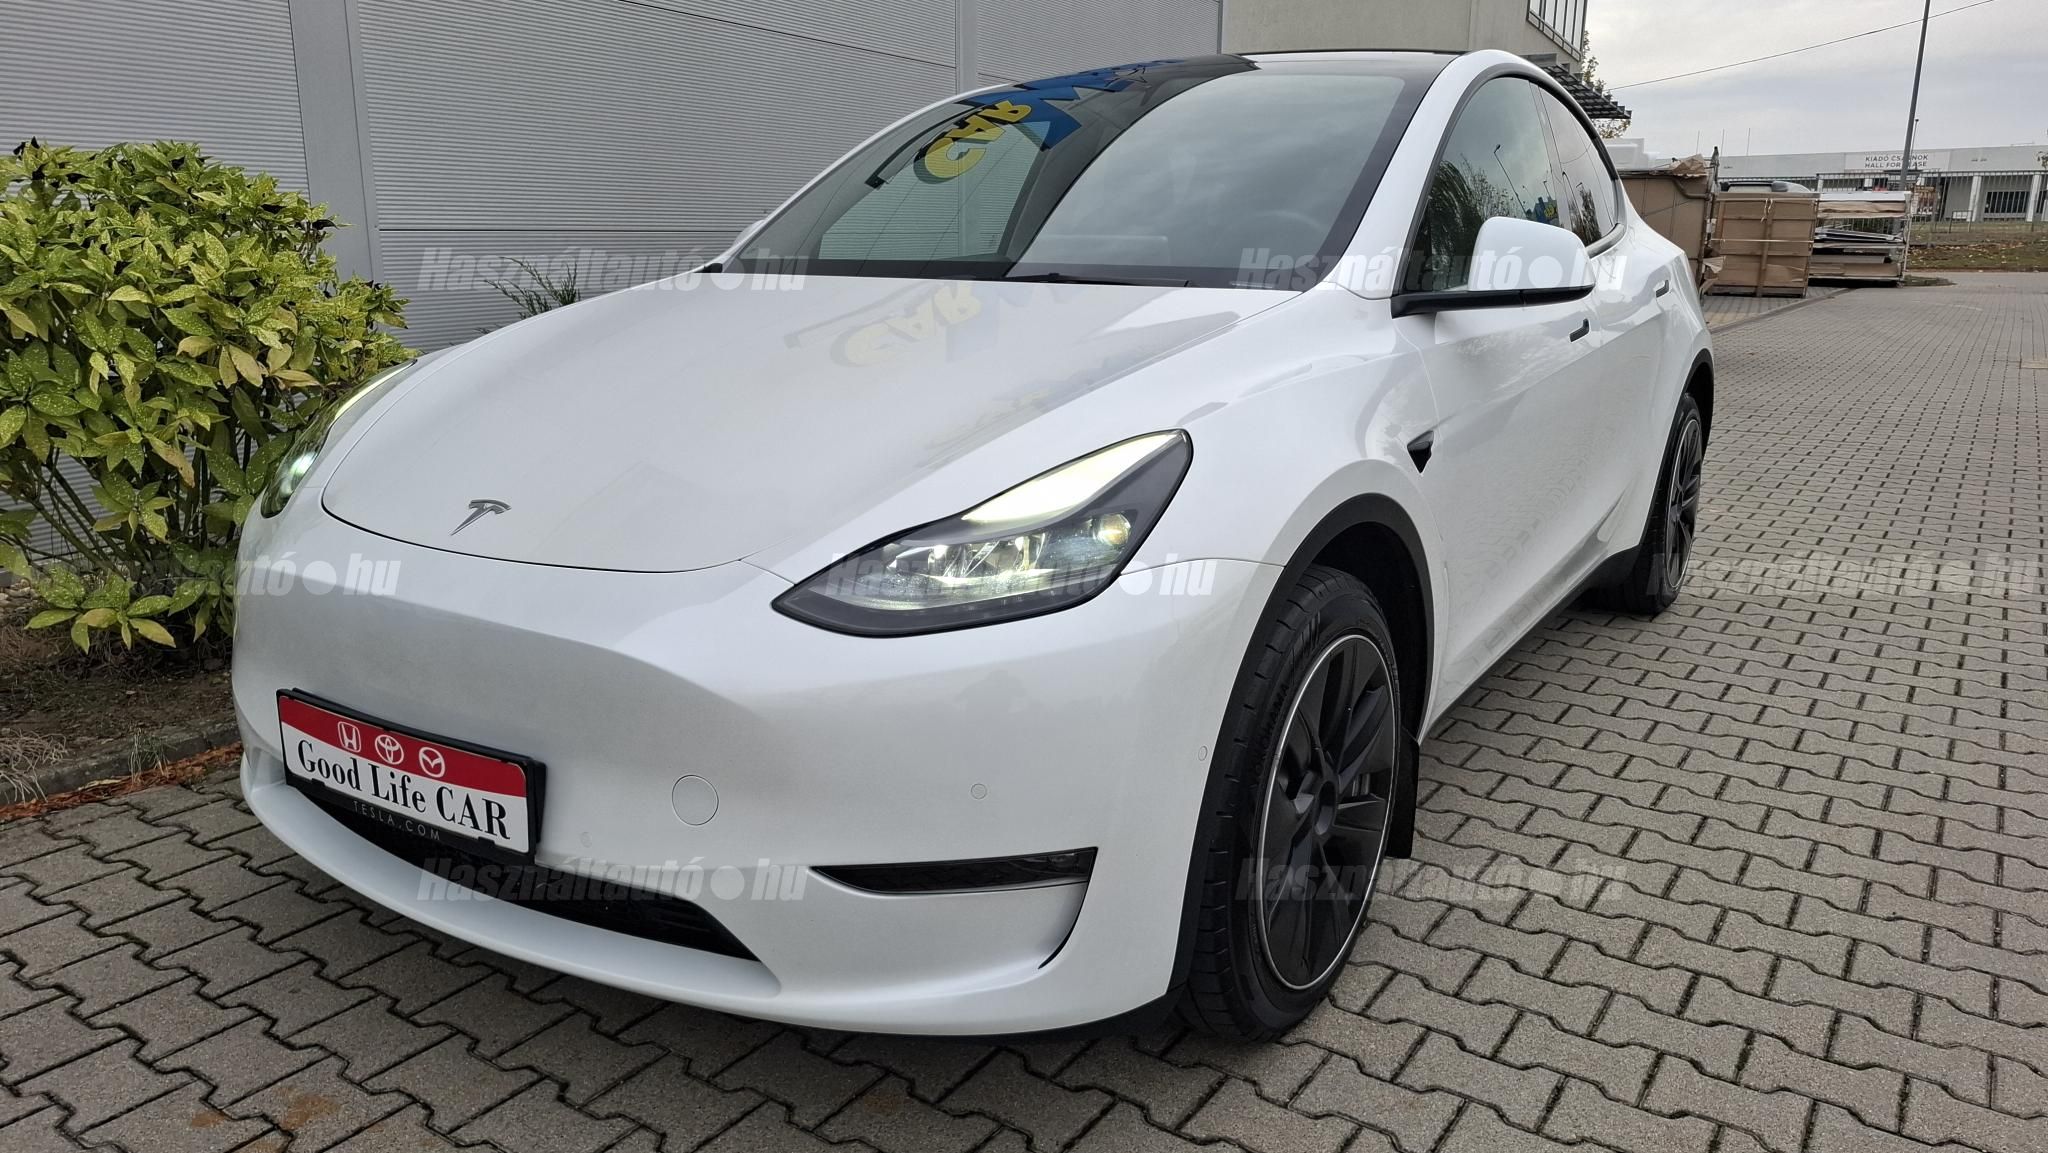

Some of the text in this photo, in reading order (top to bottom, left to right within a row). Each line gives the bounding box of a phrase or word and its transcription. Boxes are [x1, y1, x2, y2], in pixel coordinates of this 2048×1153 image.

[1865, 154, 1889, 162] KIADÓ
[297, 739, 511, 840] Good Life CAR
[353, 801, 441, 841] TESLA.COM
